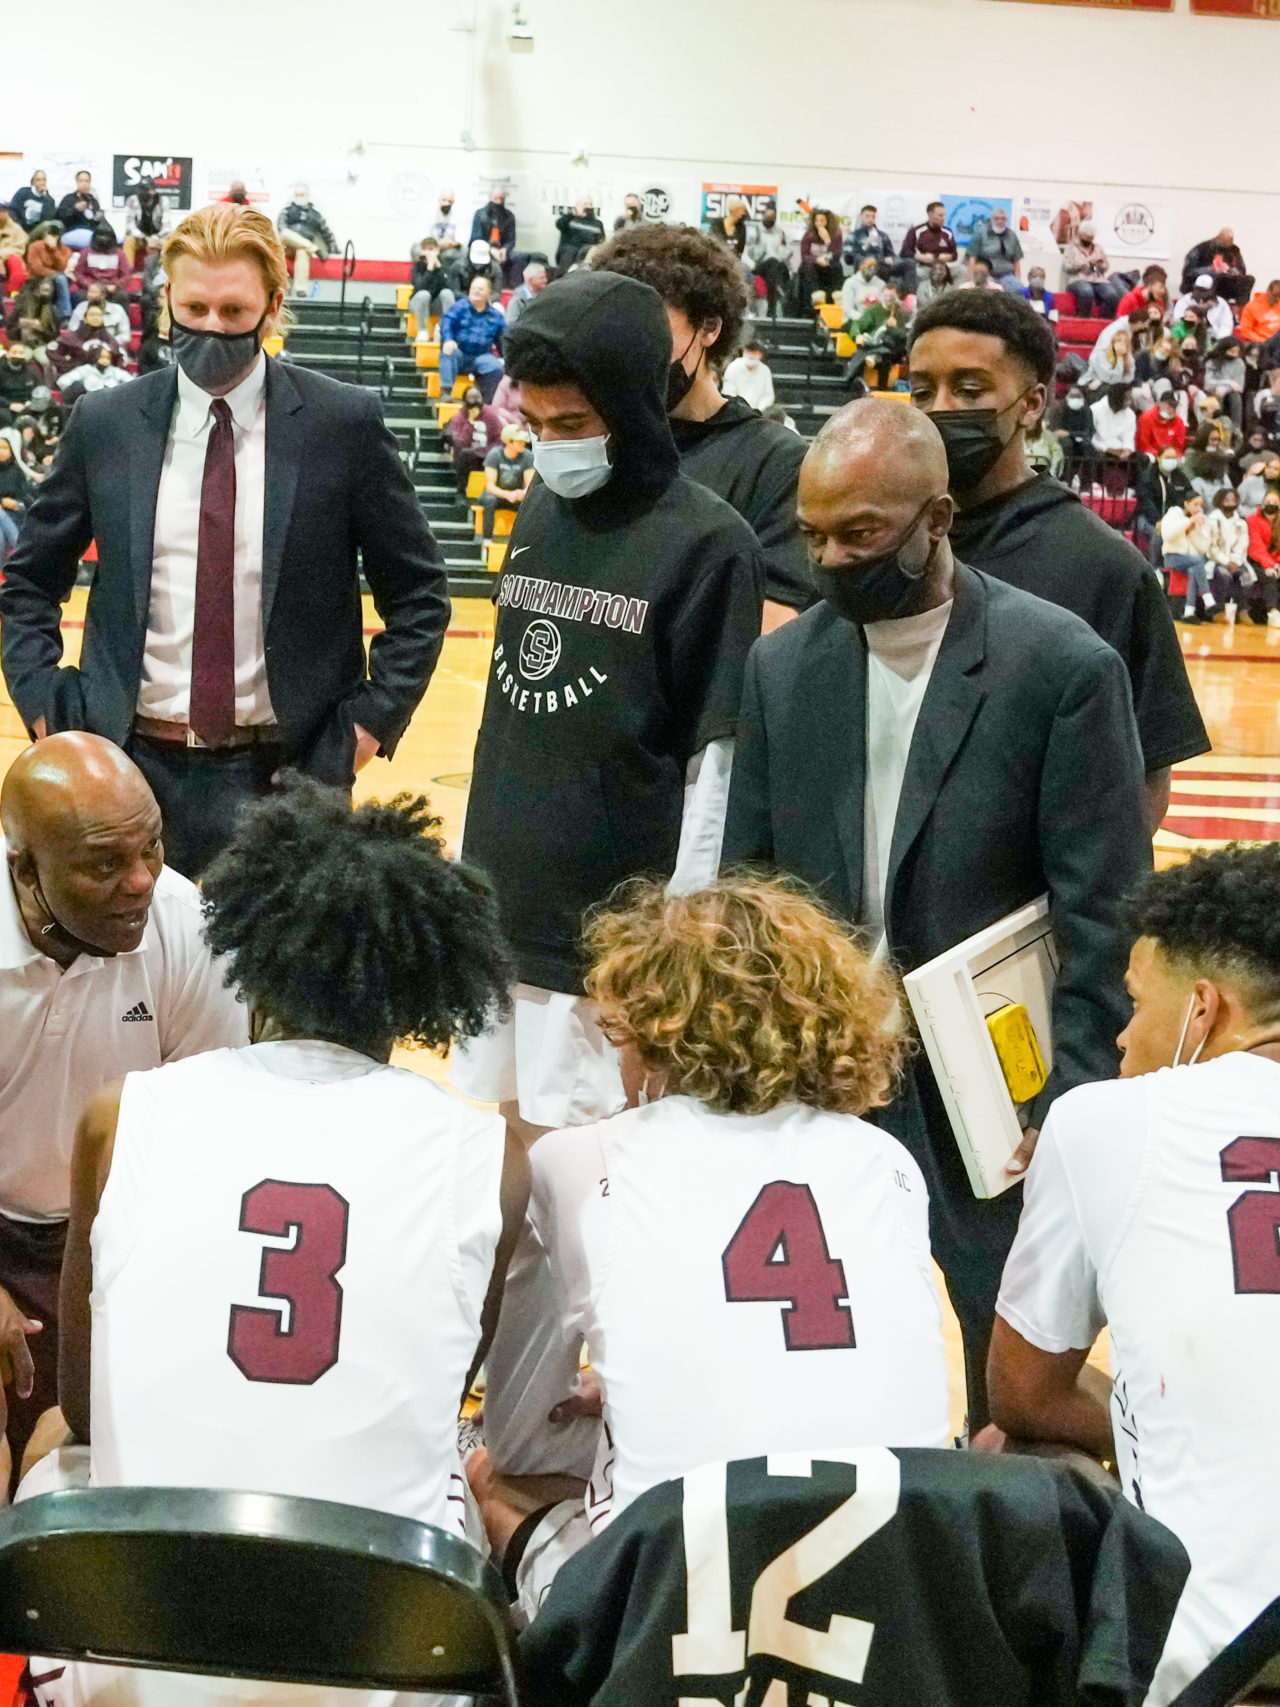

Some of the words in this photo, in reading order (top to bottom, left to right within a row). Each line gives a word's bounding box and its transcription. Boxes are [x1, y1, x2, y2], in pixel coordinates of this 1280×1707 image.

[499, 573, 650, 634] SOUTHAMPTON
[494, 643, 608, 714] BASKETBALL
[526, 629, 551, 670] S
[121, 1014, 154, 1022] adidas
[226, 1178, 350, 1386] 3
[721, 1179, 857, 1351] 4
[671, 1446, 900, 1684] 12
